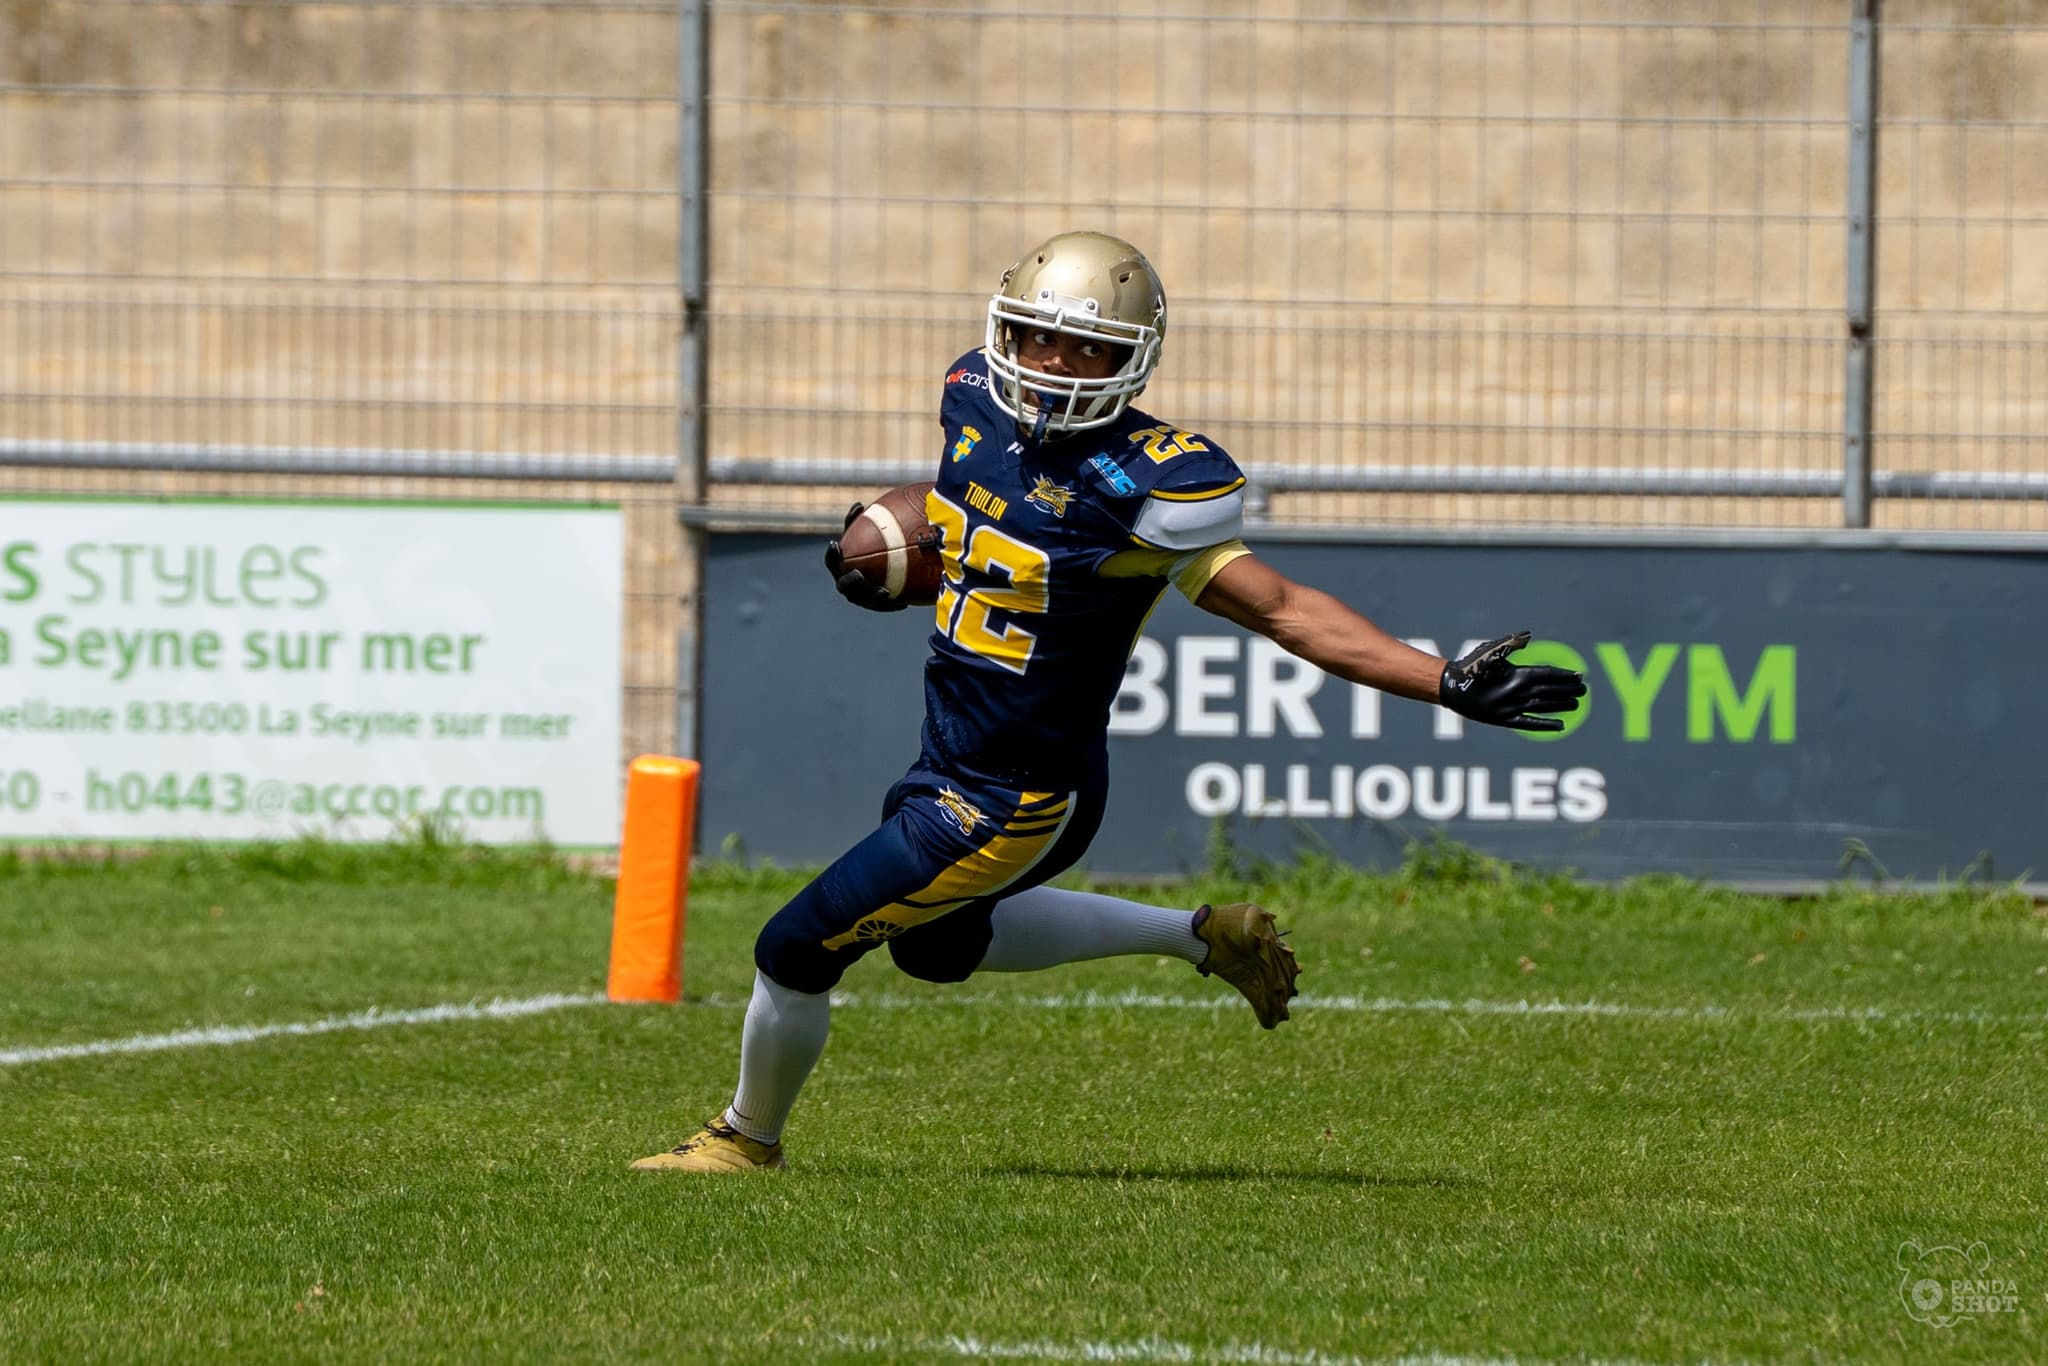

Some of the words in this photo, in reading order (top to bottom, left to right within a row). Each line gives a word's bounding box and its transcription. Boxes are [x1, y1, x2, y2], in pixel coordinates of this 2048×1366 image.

[1128, 425, 1210, 464] 22
[964, 481, 1008, 520] TOULON
[926, 488, 1050, 676] 22
[35, 613, 223, 681] Seyne
[244, 629, 342, 672] sur
[362, 631, 484, 673] mer
[125, 701, 249, 735] 83500
[259, 705, 300, 735] La
[309, 703, 419, 743] Seyne
[430, 714, 488, 738] sur
[500, 714, 573, 740] mer
[1185, 762, 1608, 822] OLLIOULES
